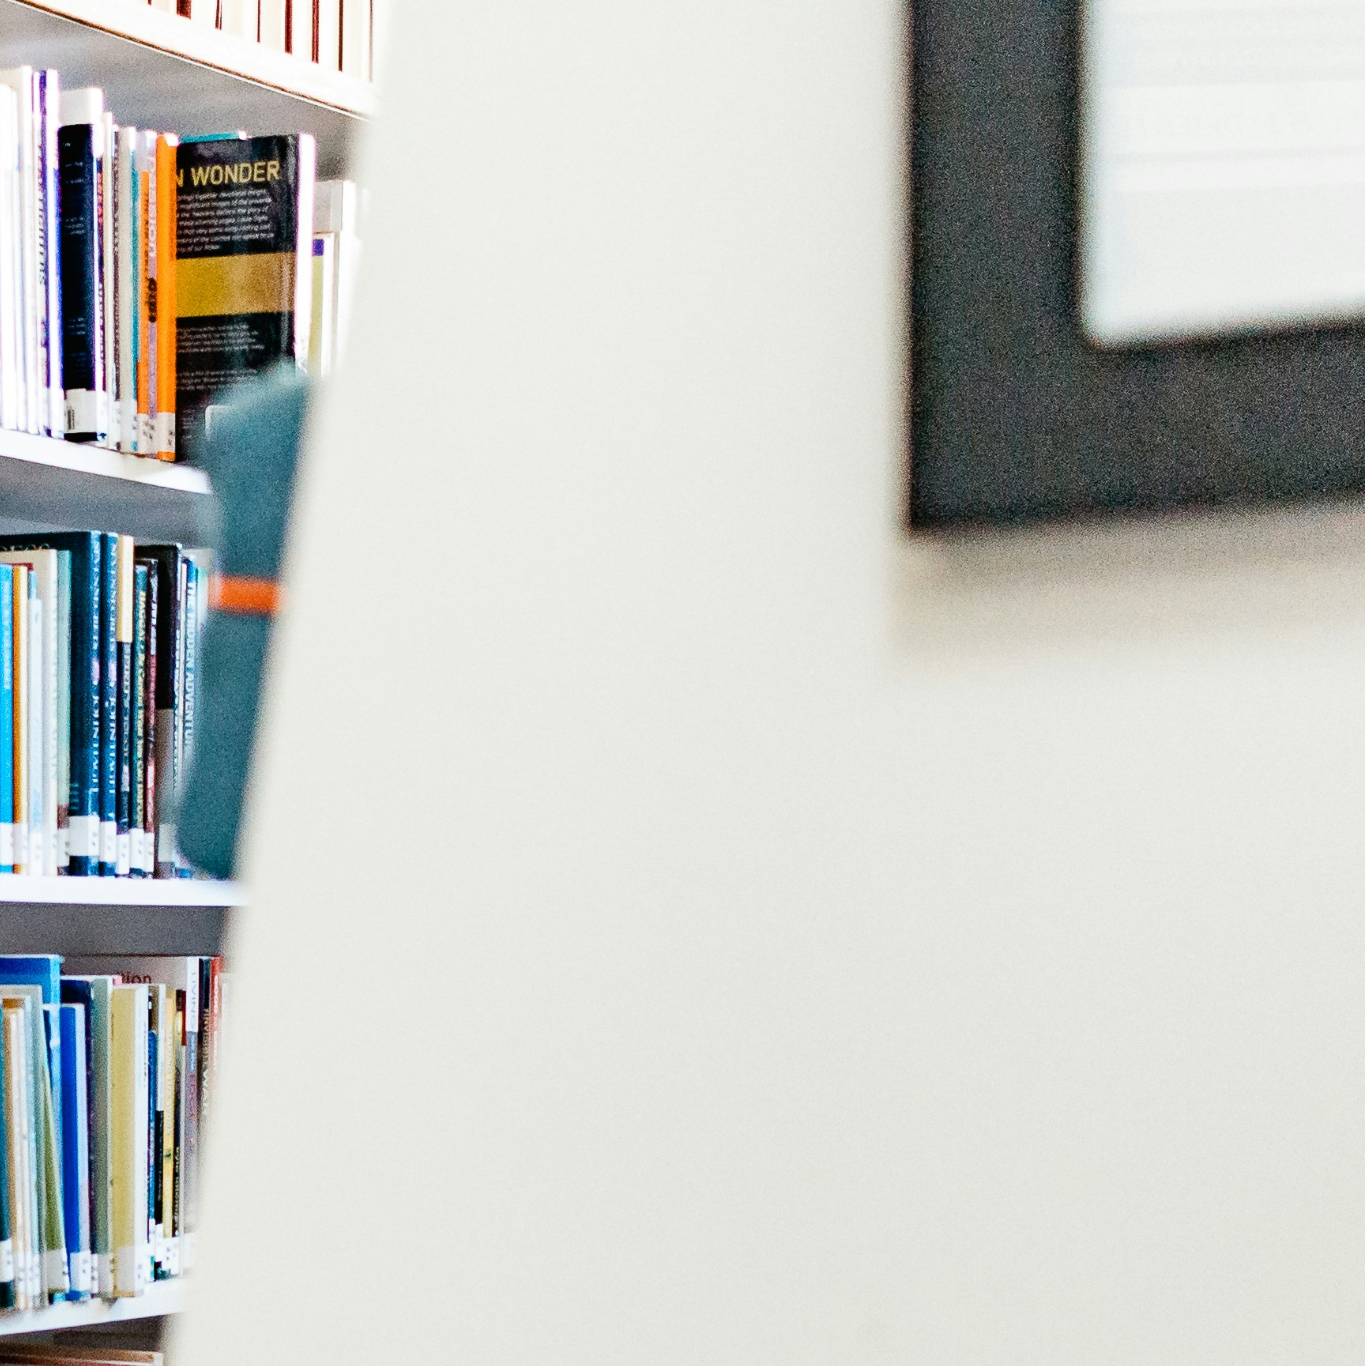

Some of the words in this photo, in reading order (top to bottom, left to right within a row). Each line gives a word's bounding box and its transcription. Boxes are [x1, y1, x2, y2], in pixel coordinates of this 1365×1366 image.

[191, 160, 280, 186] WONDER
[187, 581, 195, 611] THE
[186, 613, 195, 671] HIDDEN
